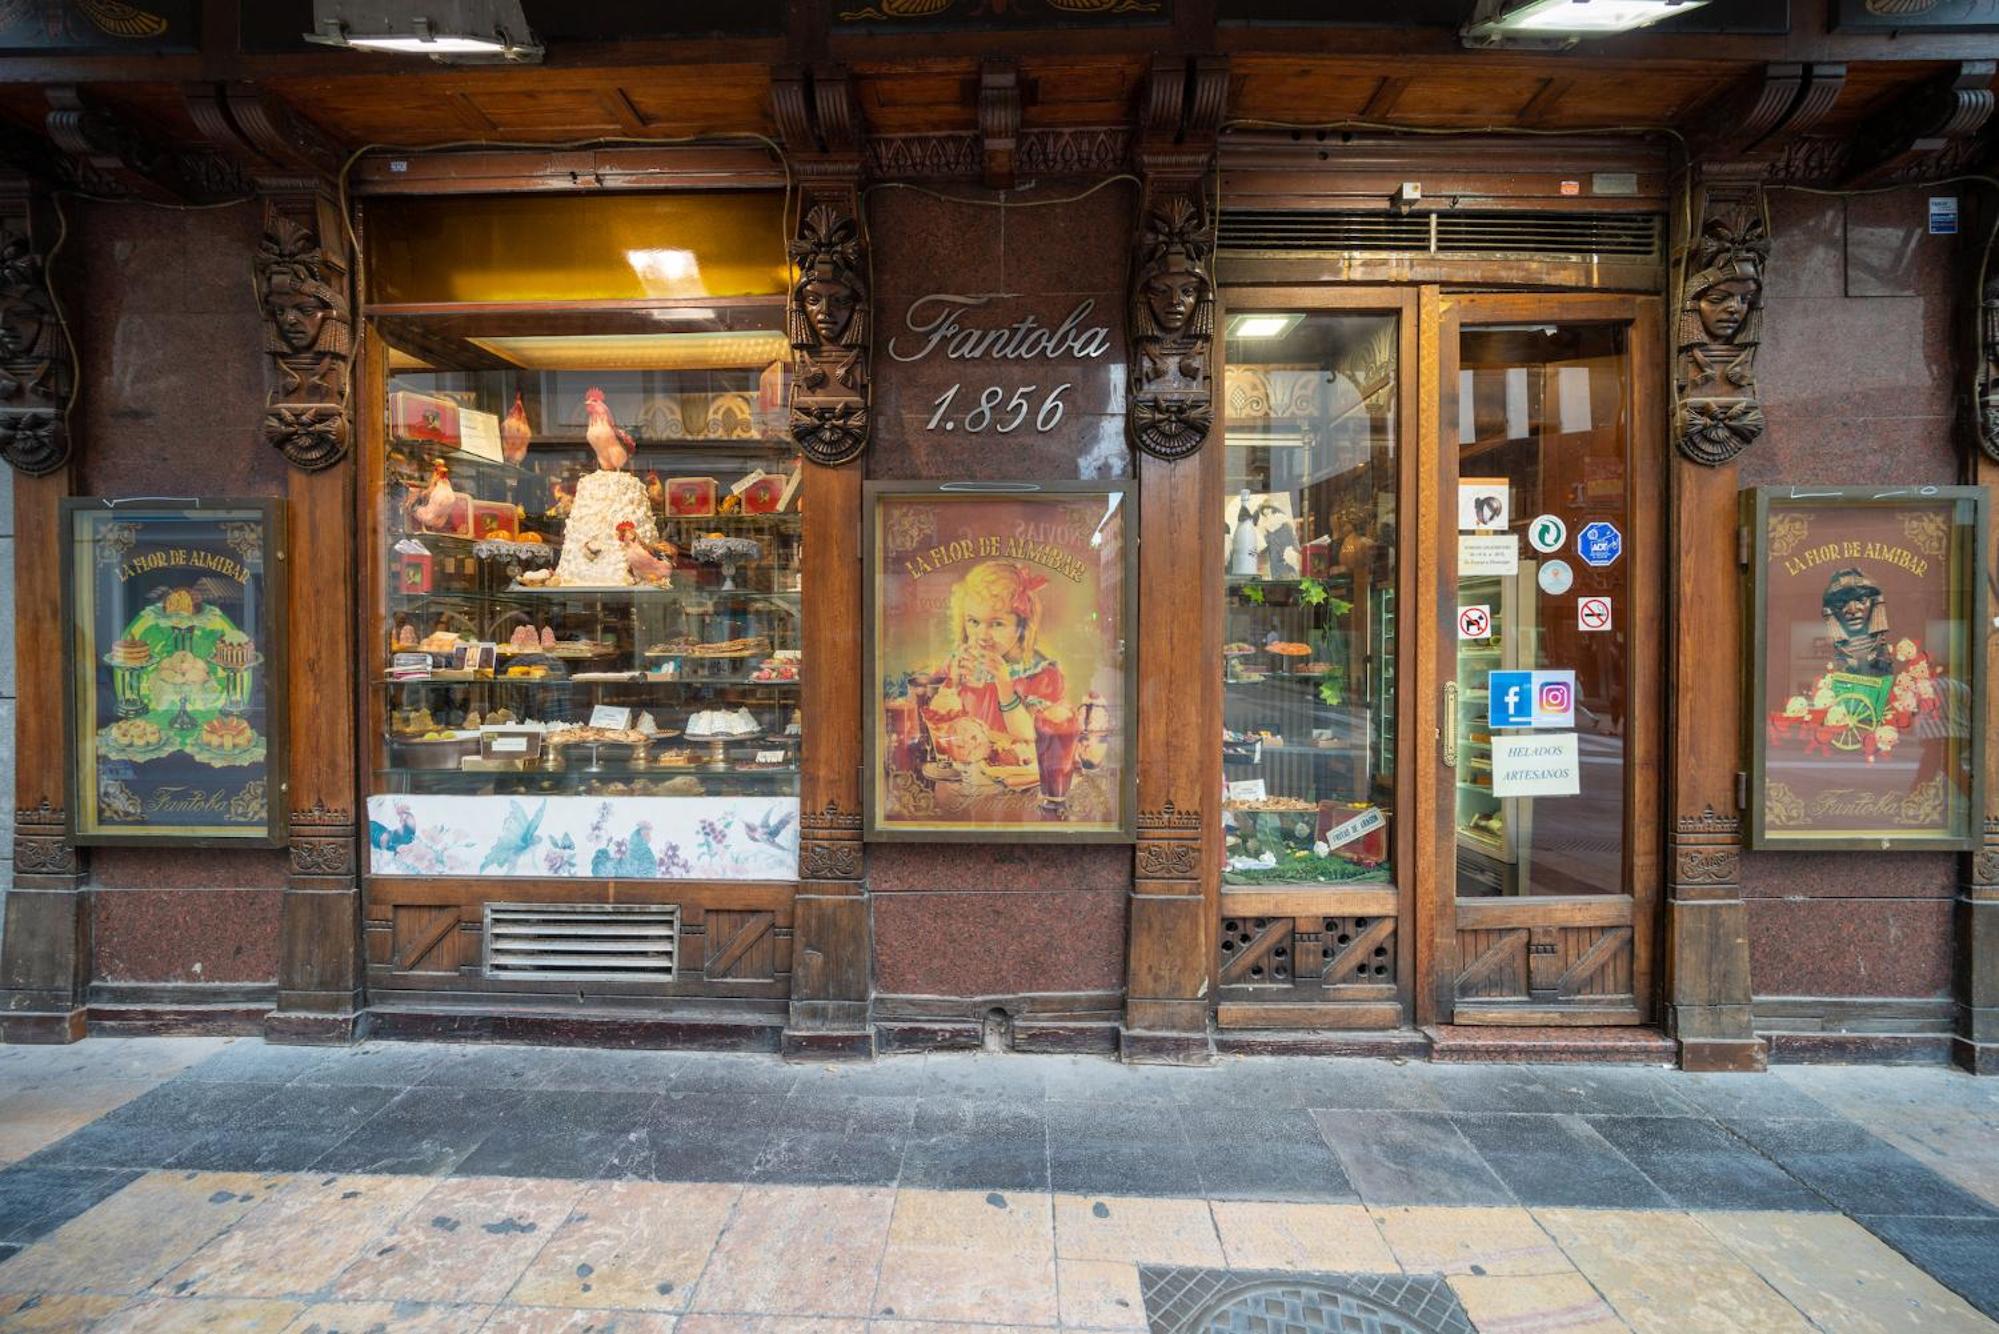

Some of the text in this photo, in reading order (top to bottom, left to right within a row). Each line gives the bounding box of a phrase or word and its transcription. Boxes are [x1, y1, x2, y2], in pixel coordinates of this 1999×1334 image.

[888, 294, 1110, 362] Fantoba
[926, 383, 1071, 434] 1.856
[115, 549, 251, 585] LA FLOR DE ALMIBAR
[904, 536, 1088, 583] LA FLOR DE ALMIBAR
[1784, 541, 1928, 578] LA FLOR DE ALMIBAR
[1507, 745, 1564, 758] HELADOS
[1503, 768, 1570, 781] ARTESANOS
[145, 784, 229, 813] Fantoba
[1811, 788, 1898, 817] Fantoba
